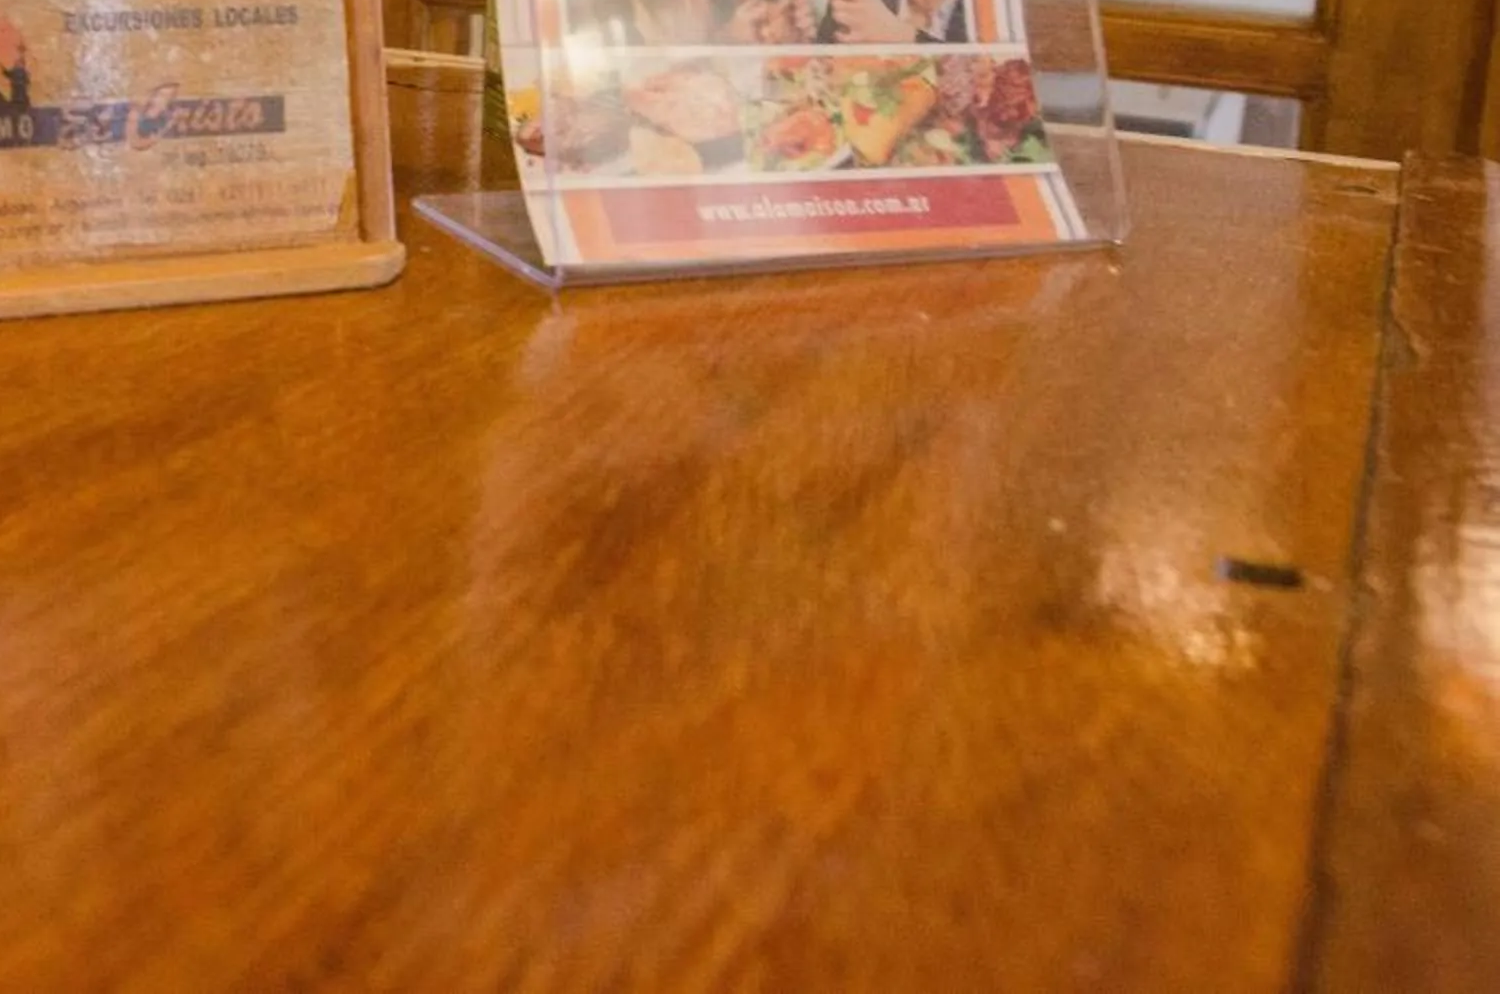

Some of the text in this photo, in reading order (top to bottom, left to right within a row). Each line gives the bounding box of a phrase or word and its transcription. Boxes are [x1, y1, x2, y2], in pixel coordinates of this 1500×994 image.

[62, 4, 299, 34] EXCURSIONES LOCALES
[124, 81, 264, 152] Cristo
[696, 193, 931, 222] www.alamaison.com.ar
